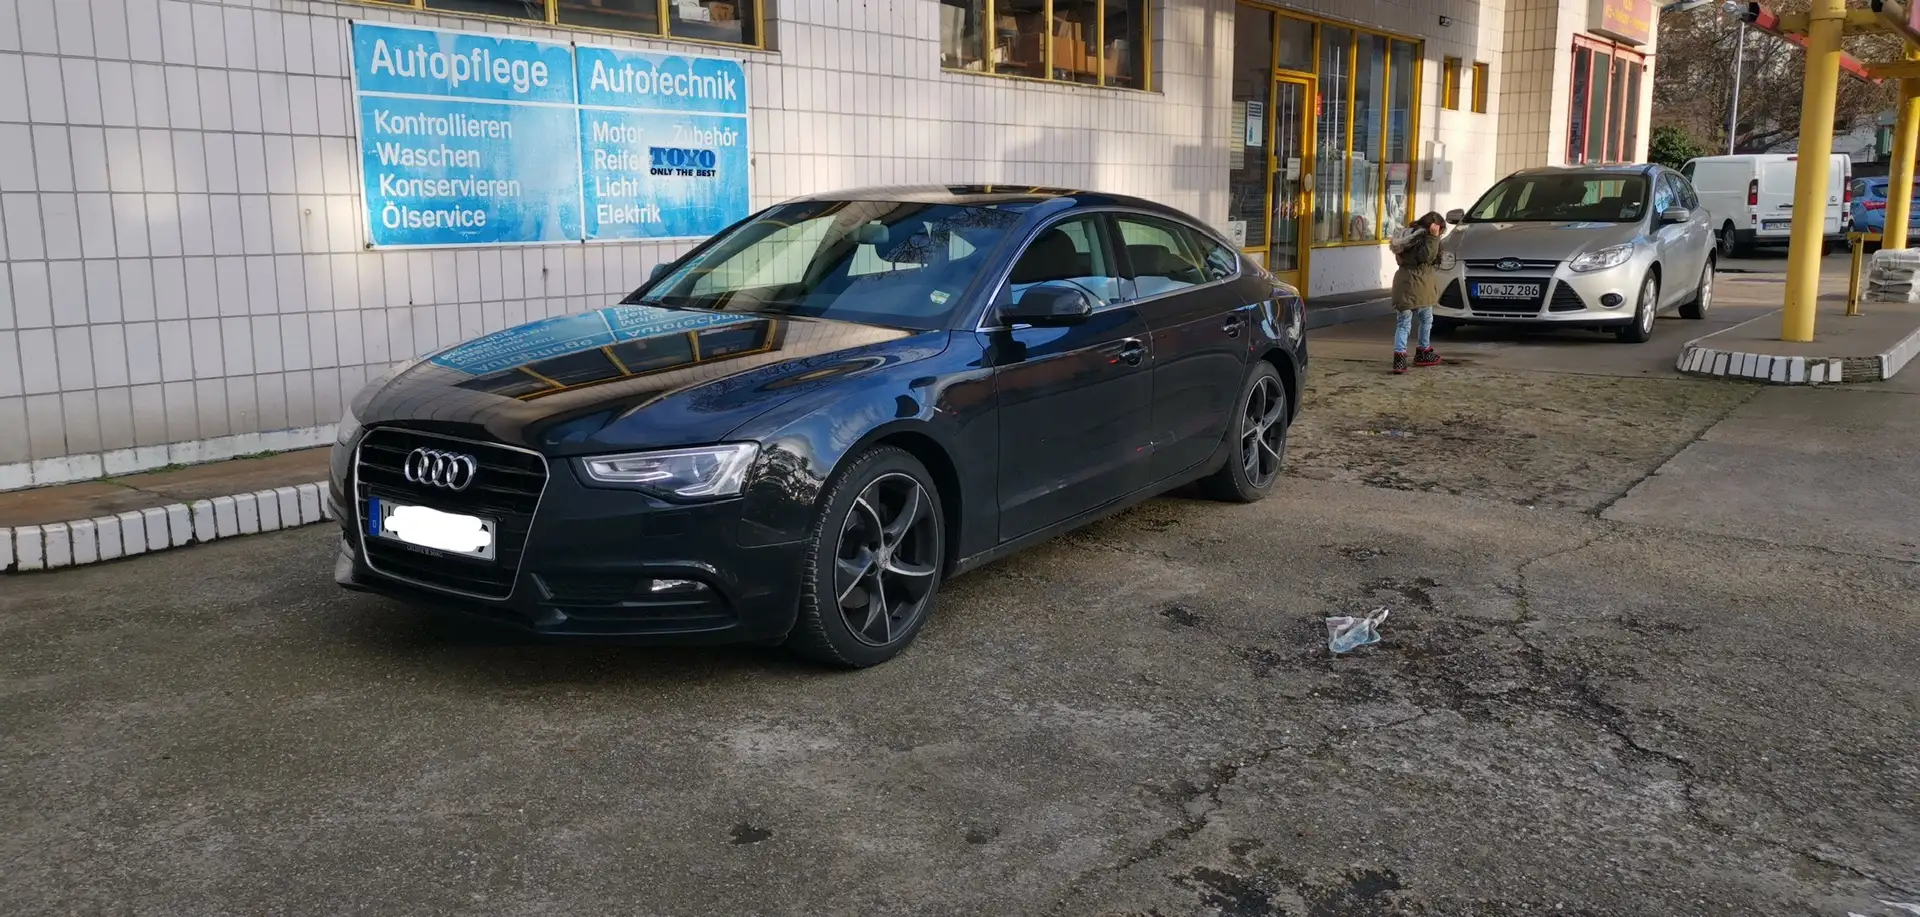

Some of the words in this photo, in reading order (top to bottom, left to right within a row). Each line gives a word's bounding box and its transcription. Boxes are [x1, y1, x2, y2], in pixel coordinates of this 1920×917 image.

[371, 38, 549, 93] Autopflege
[590, 59, 737, 100] Autotechnik
[374, 109, 513, 140] Kontrollieren
[593, 121, 644, 144] Motor
[673, 125, 738, 147] Zubehör
[375, 141, 481, 168] Waschen
[650, 147, 716, 168] TOYO
[650, 167, 674, 176] ONLY
[676, 168, 693, 176] THE
[696, 169, 716, 177] BEST
[379, 173, 521, 198] Konservieren
[596, 176, 638, 198] Licht
[382, 201, 487, 229] Ölservice
[597, 203, 662, 225] Elektrik
[1479, 285, 1492, 295] WO
[1501, 285, 1514, 296] JZ
[1517, 286, 1538, 296] 286
